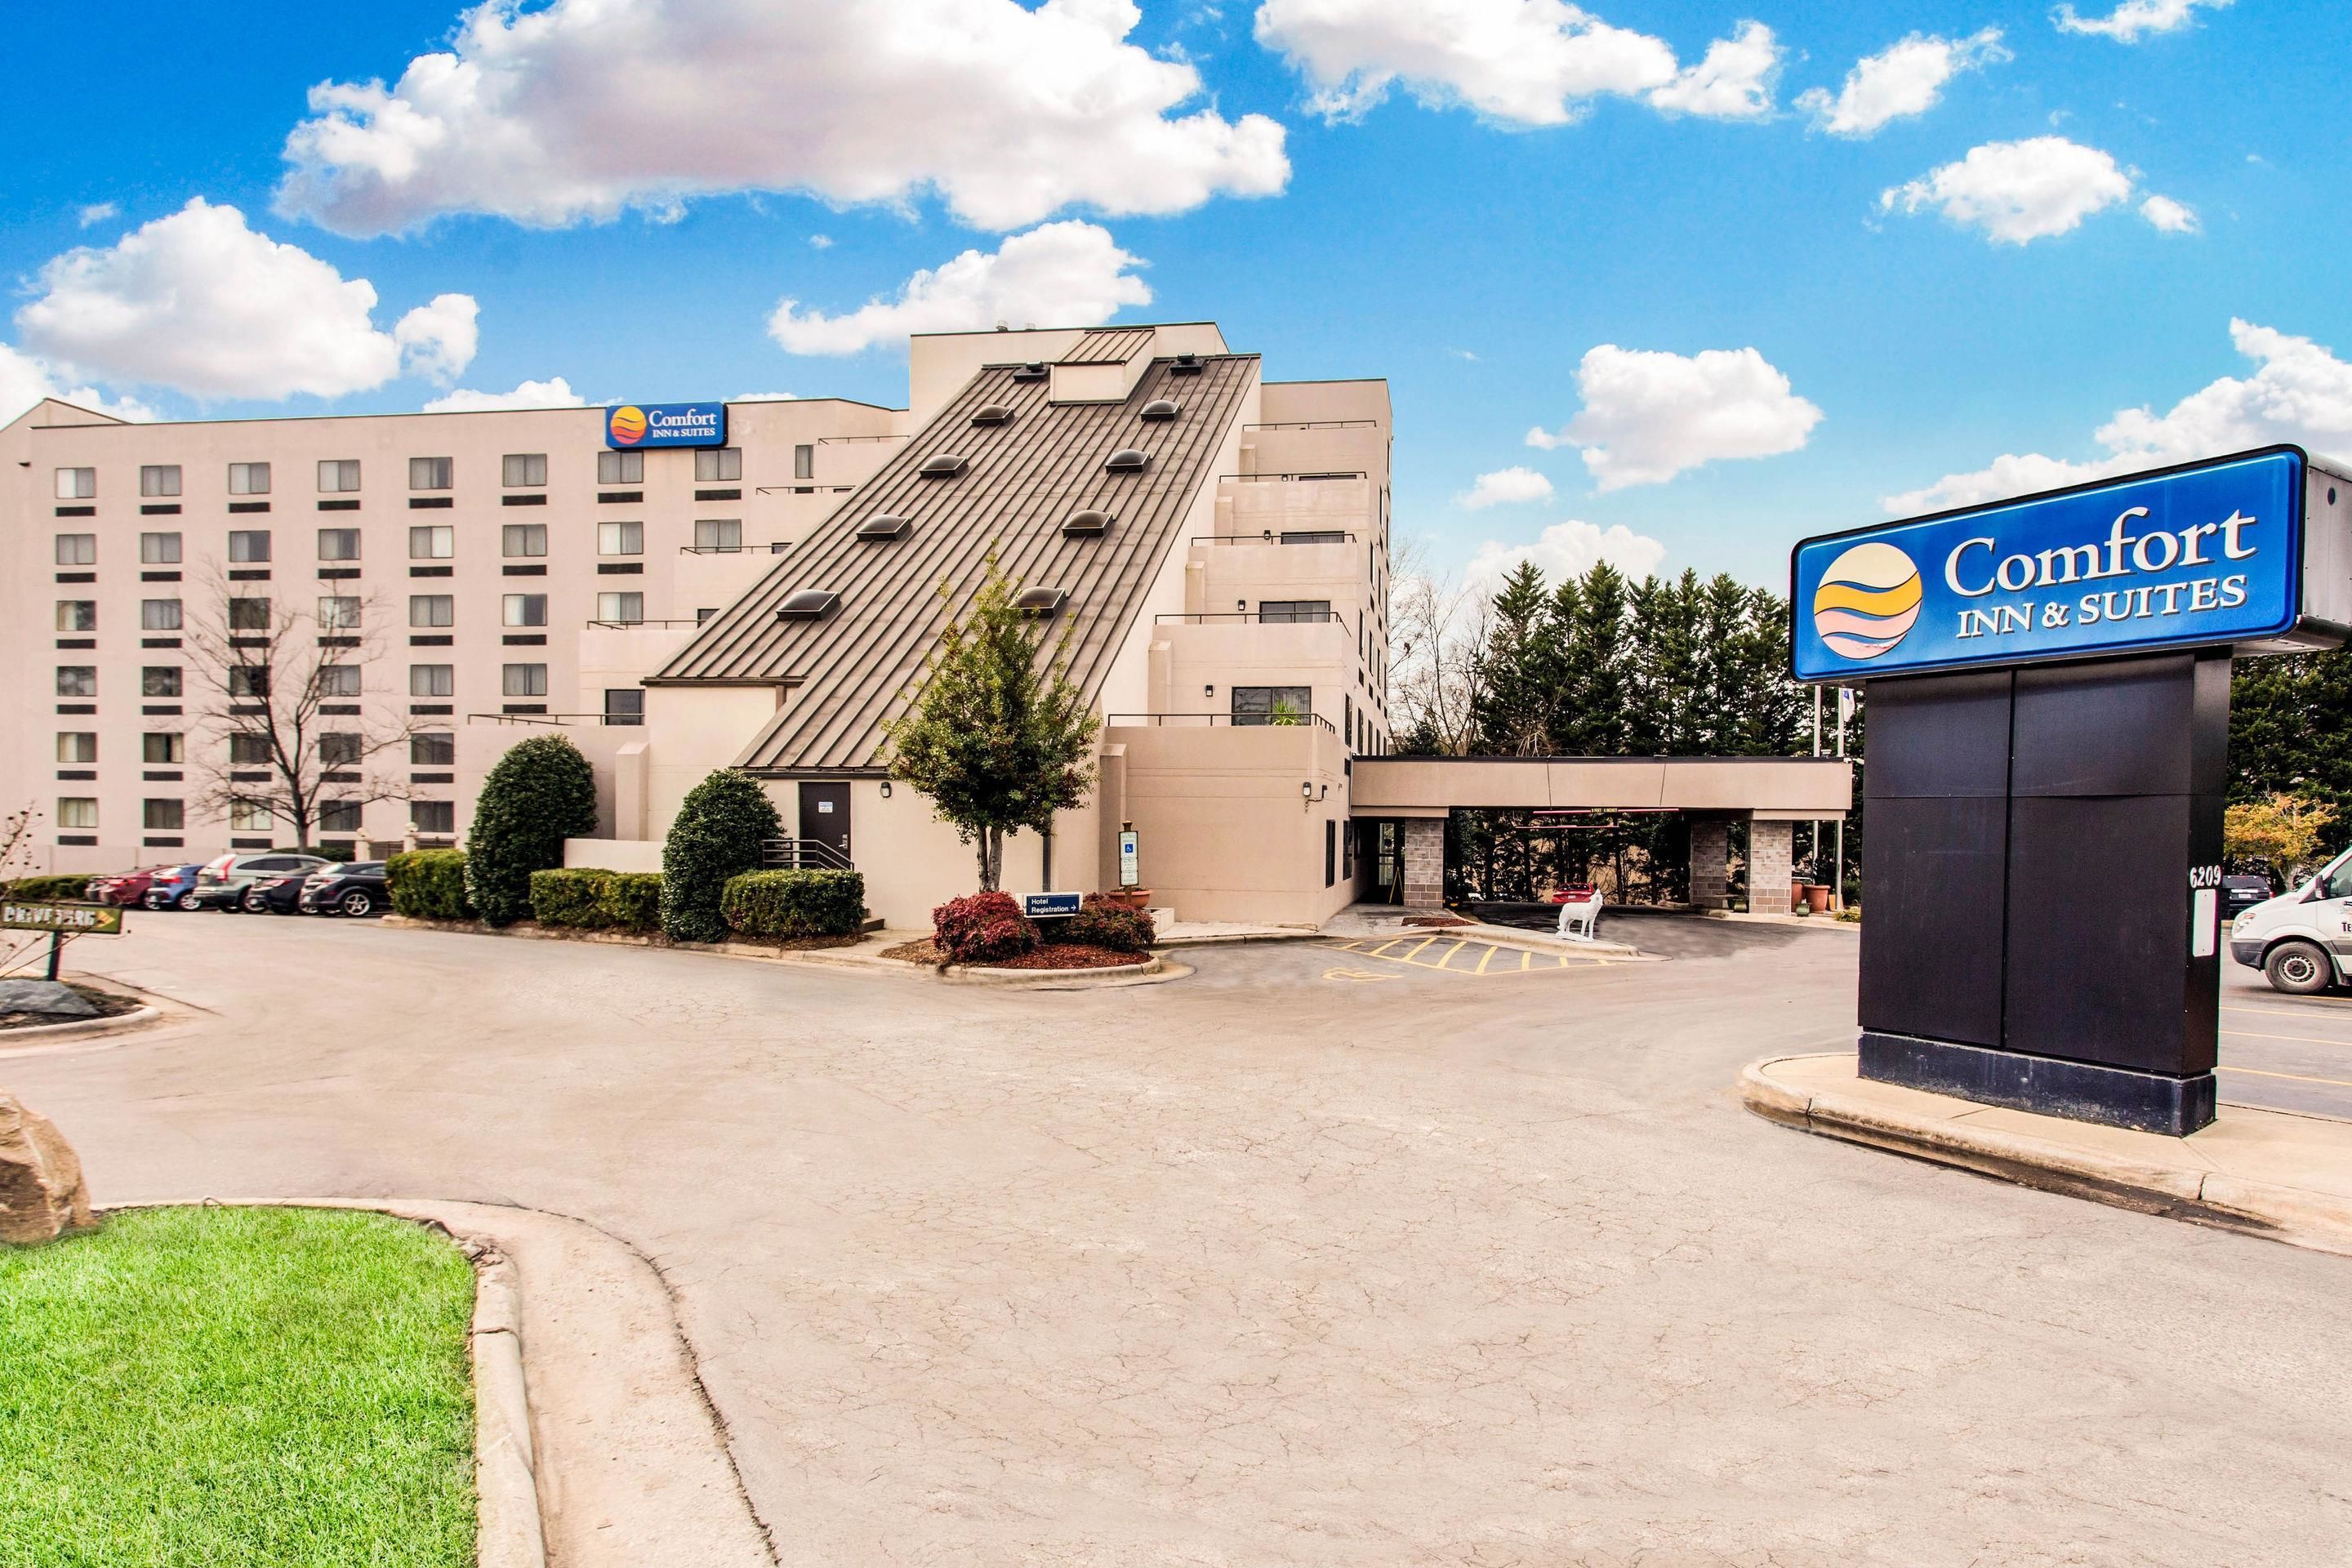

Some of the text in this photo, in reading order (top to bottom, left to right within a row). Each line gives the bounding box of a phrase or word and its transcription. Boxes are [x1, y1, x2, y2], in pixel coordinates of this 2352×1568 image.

[648, 408, 717, 427] Comfort
[653, 427, 715, 438] INN & SUITES
[1944, 506, 2259, 598] Comfort
[1956, 574, 2248, 639] INN & SUITES
[2189, 865, 2221, 889] 6209
[1031, 906, 1069, 914] Registration
